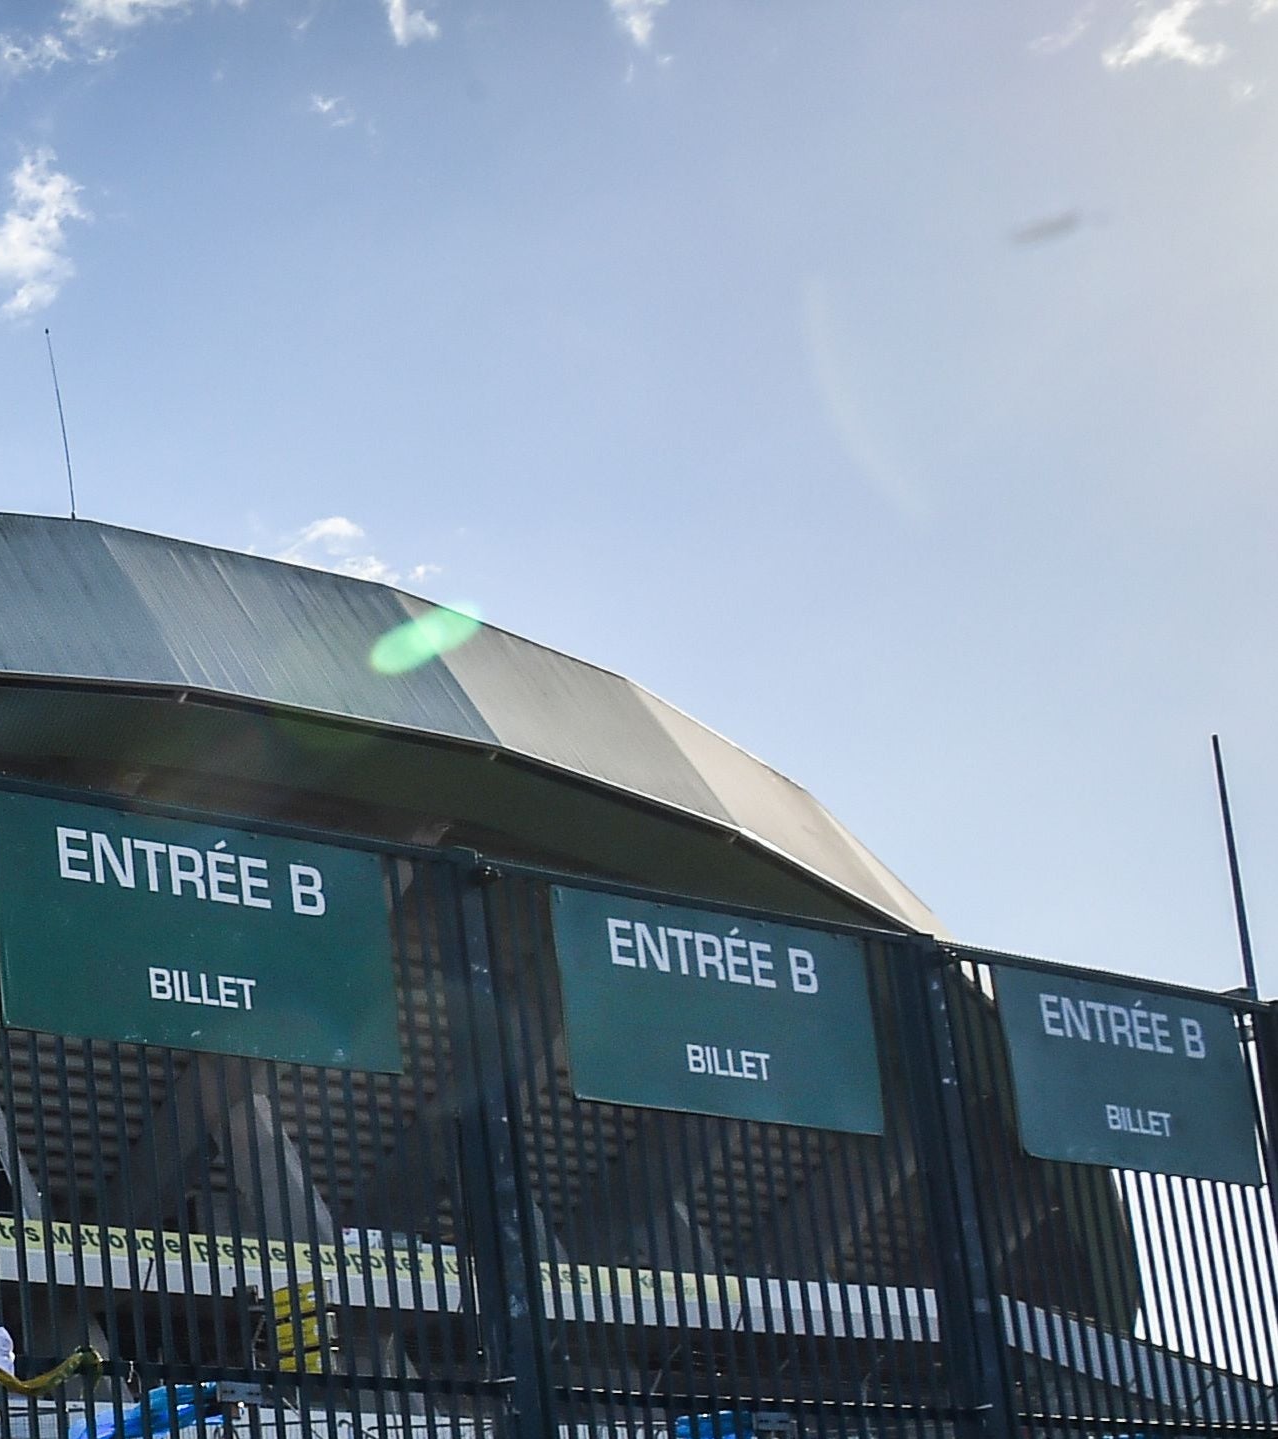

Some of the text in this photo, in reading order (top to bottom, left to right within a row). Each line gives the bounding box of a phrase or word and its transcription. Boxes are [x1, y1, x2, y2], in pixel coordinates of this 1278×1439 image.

[56, 826, 327, 917] ENTRÉE B
[607, 917, 819, 994] ENTRÉE B
[149, 967, 256, 1011] BILLET
[1039, 994, 1206, 1059] ENTRÉE B
[686, 1044, 771, 1081] BILLET
[1106, 1104, 1173, 1138] BILLET
